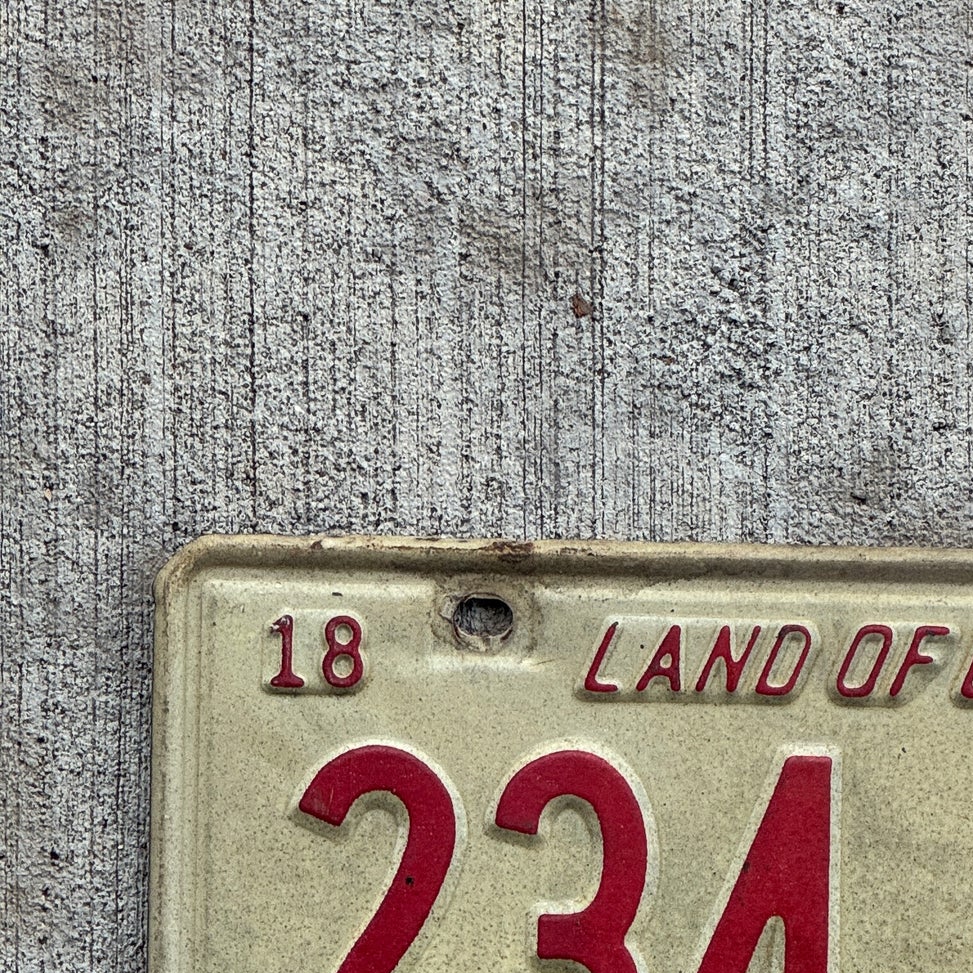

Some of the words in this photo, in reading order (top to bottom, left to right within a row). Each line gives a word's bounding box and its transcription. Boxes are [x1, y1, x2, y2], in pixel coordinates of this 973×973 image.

[270, 614, 365, 690] 18
[583, 621, 812, 697] LAND
[835, 622, 951, 699] OF
